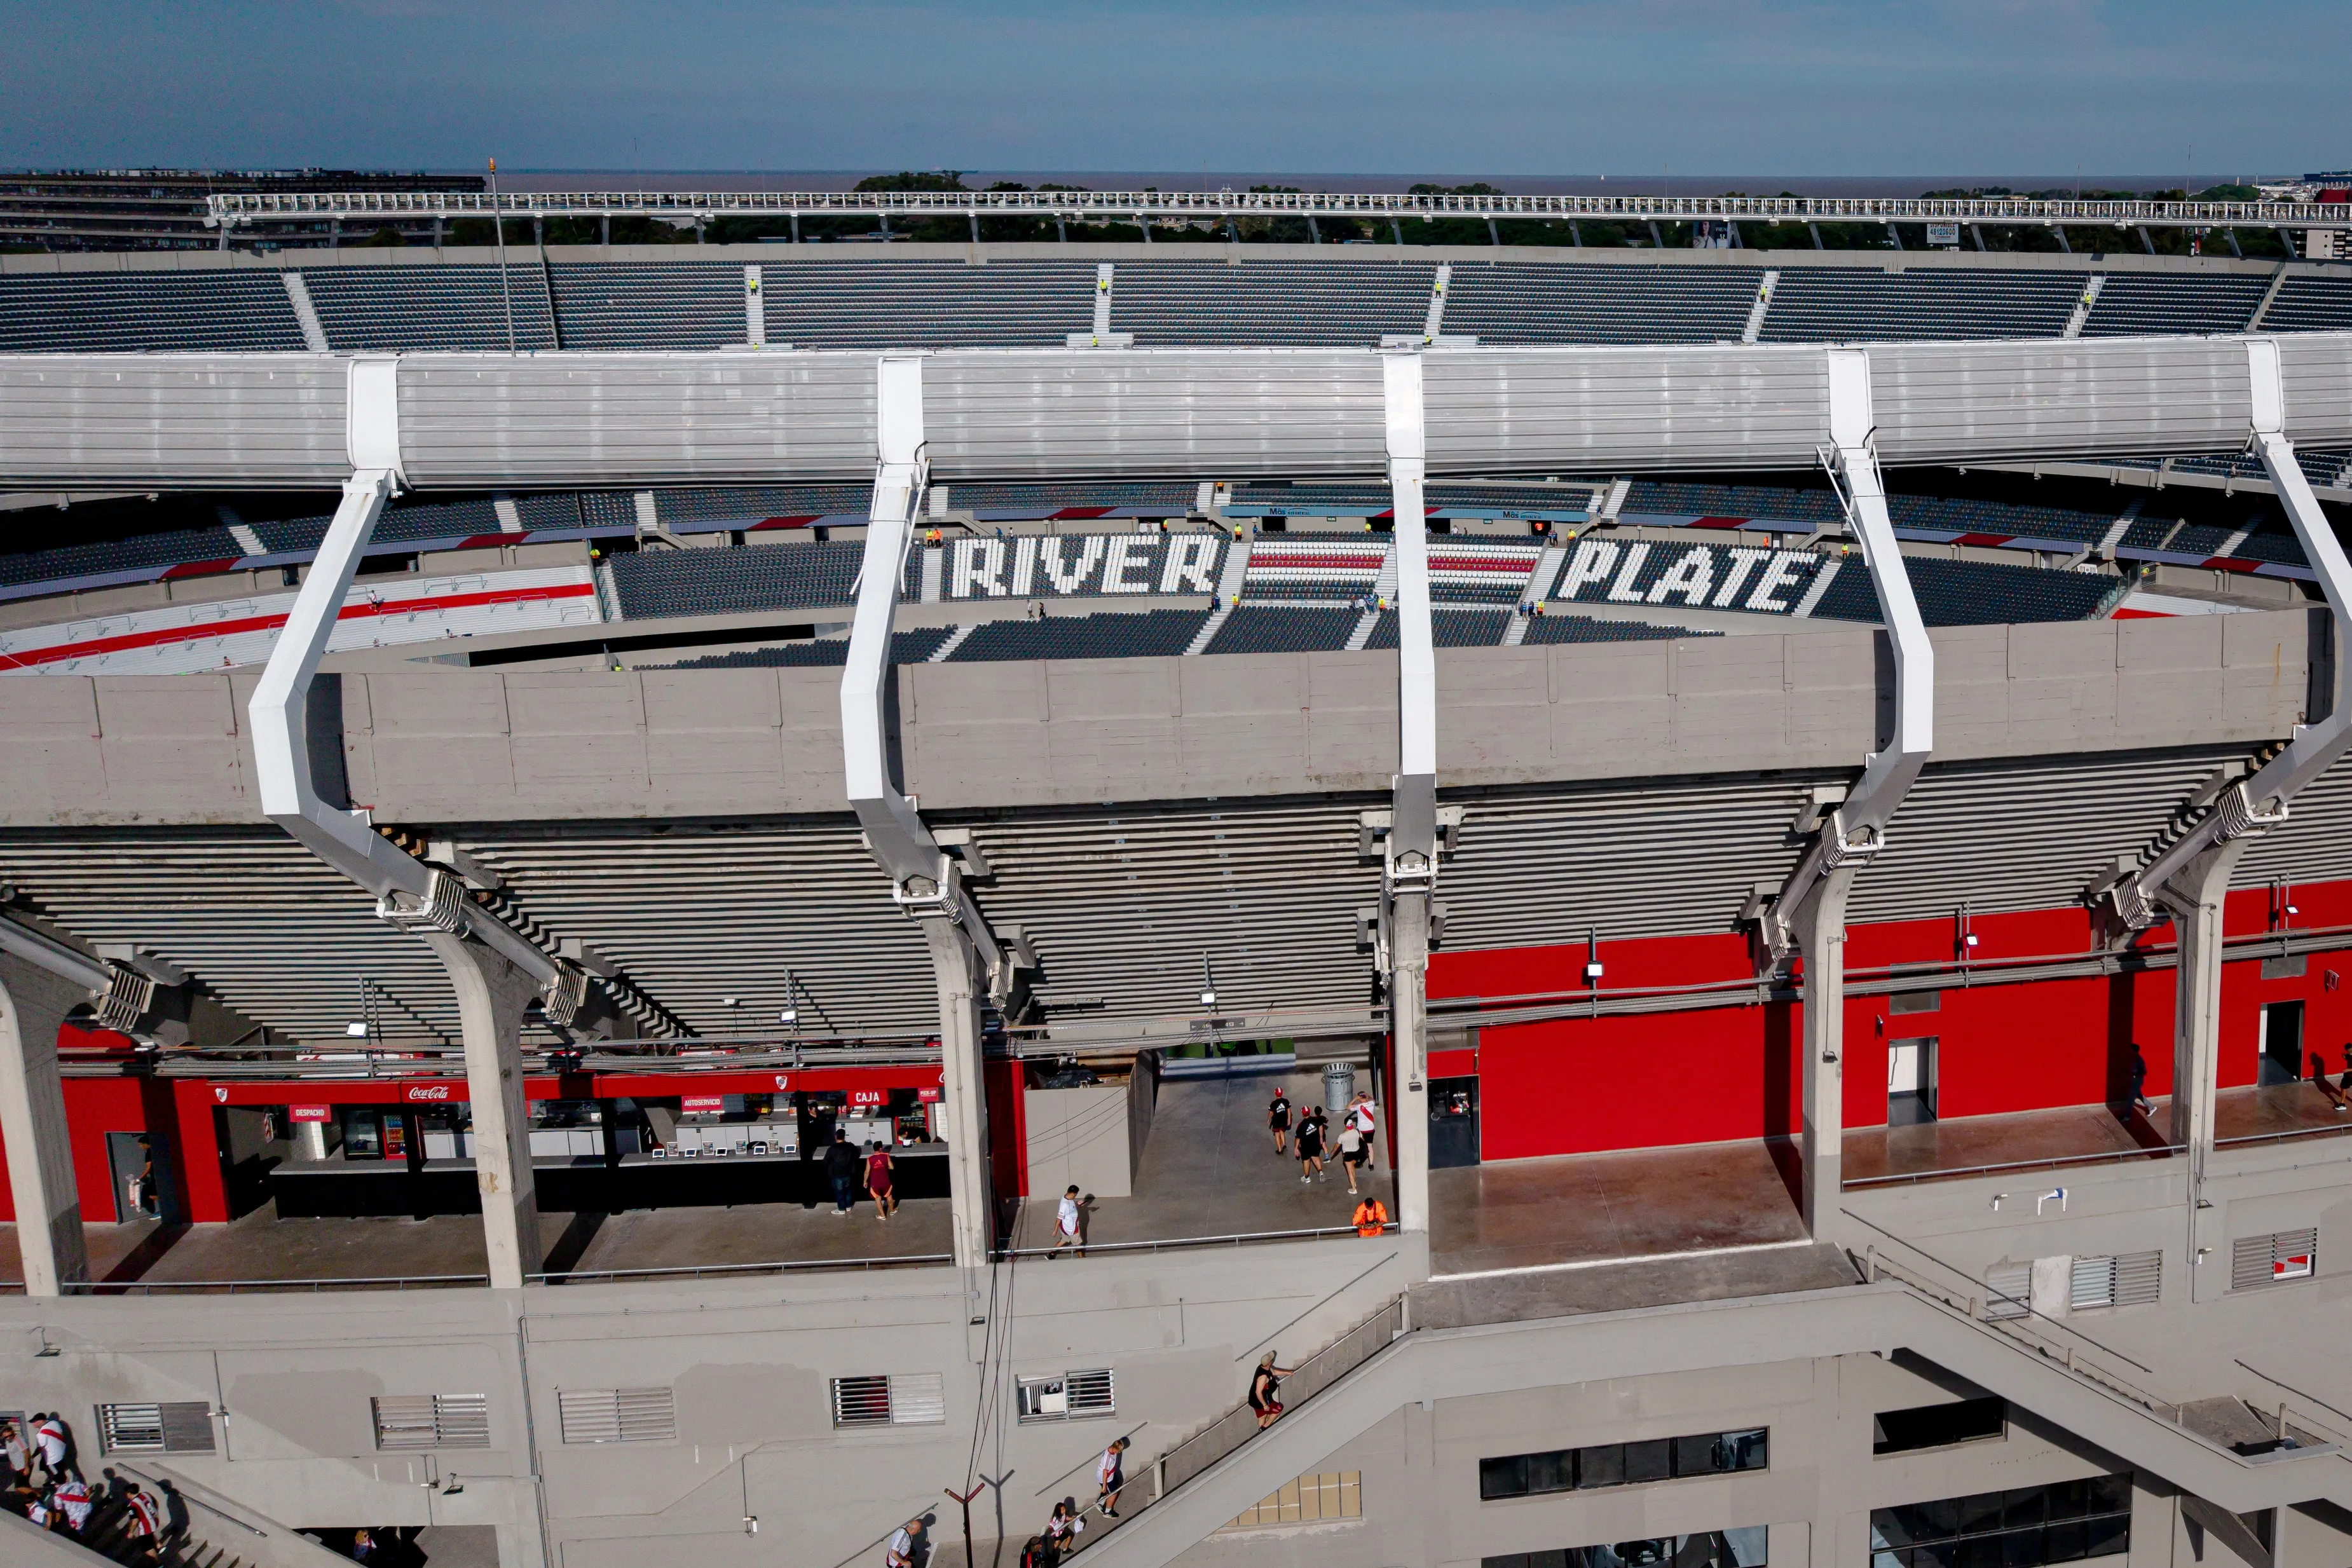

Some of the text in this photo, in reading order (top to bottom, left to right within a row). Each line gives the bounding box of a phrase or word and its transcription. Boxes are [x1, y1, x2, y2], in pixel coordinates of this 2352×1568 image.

[952, 535, 1817, 611] RIVER PLATE
[409, 1086, 449, 1099] Coca-Cola
[856, 1092, 880, 1102] CAJA
